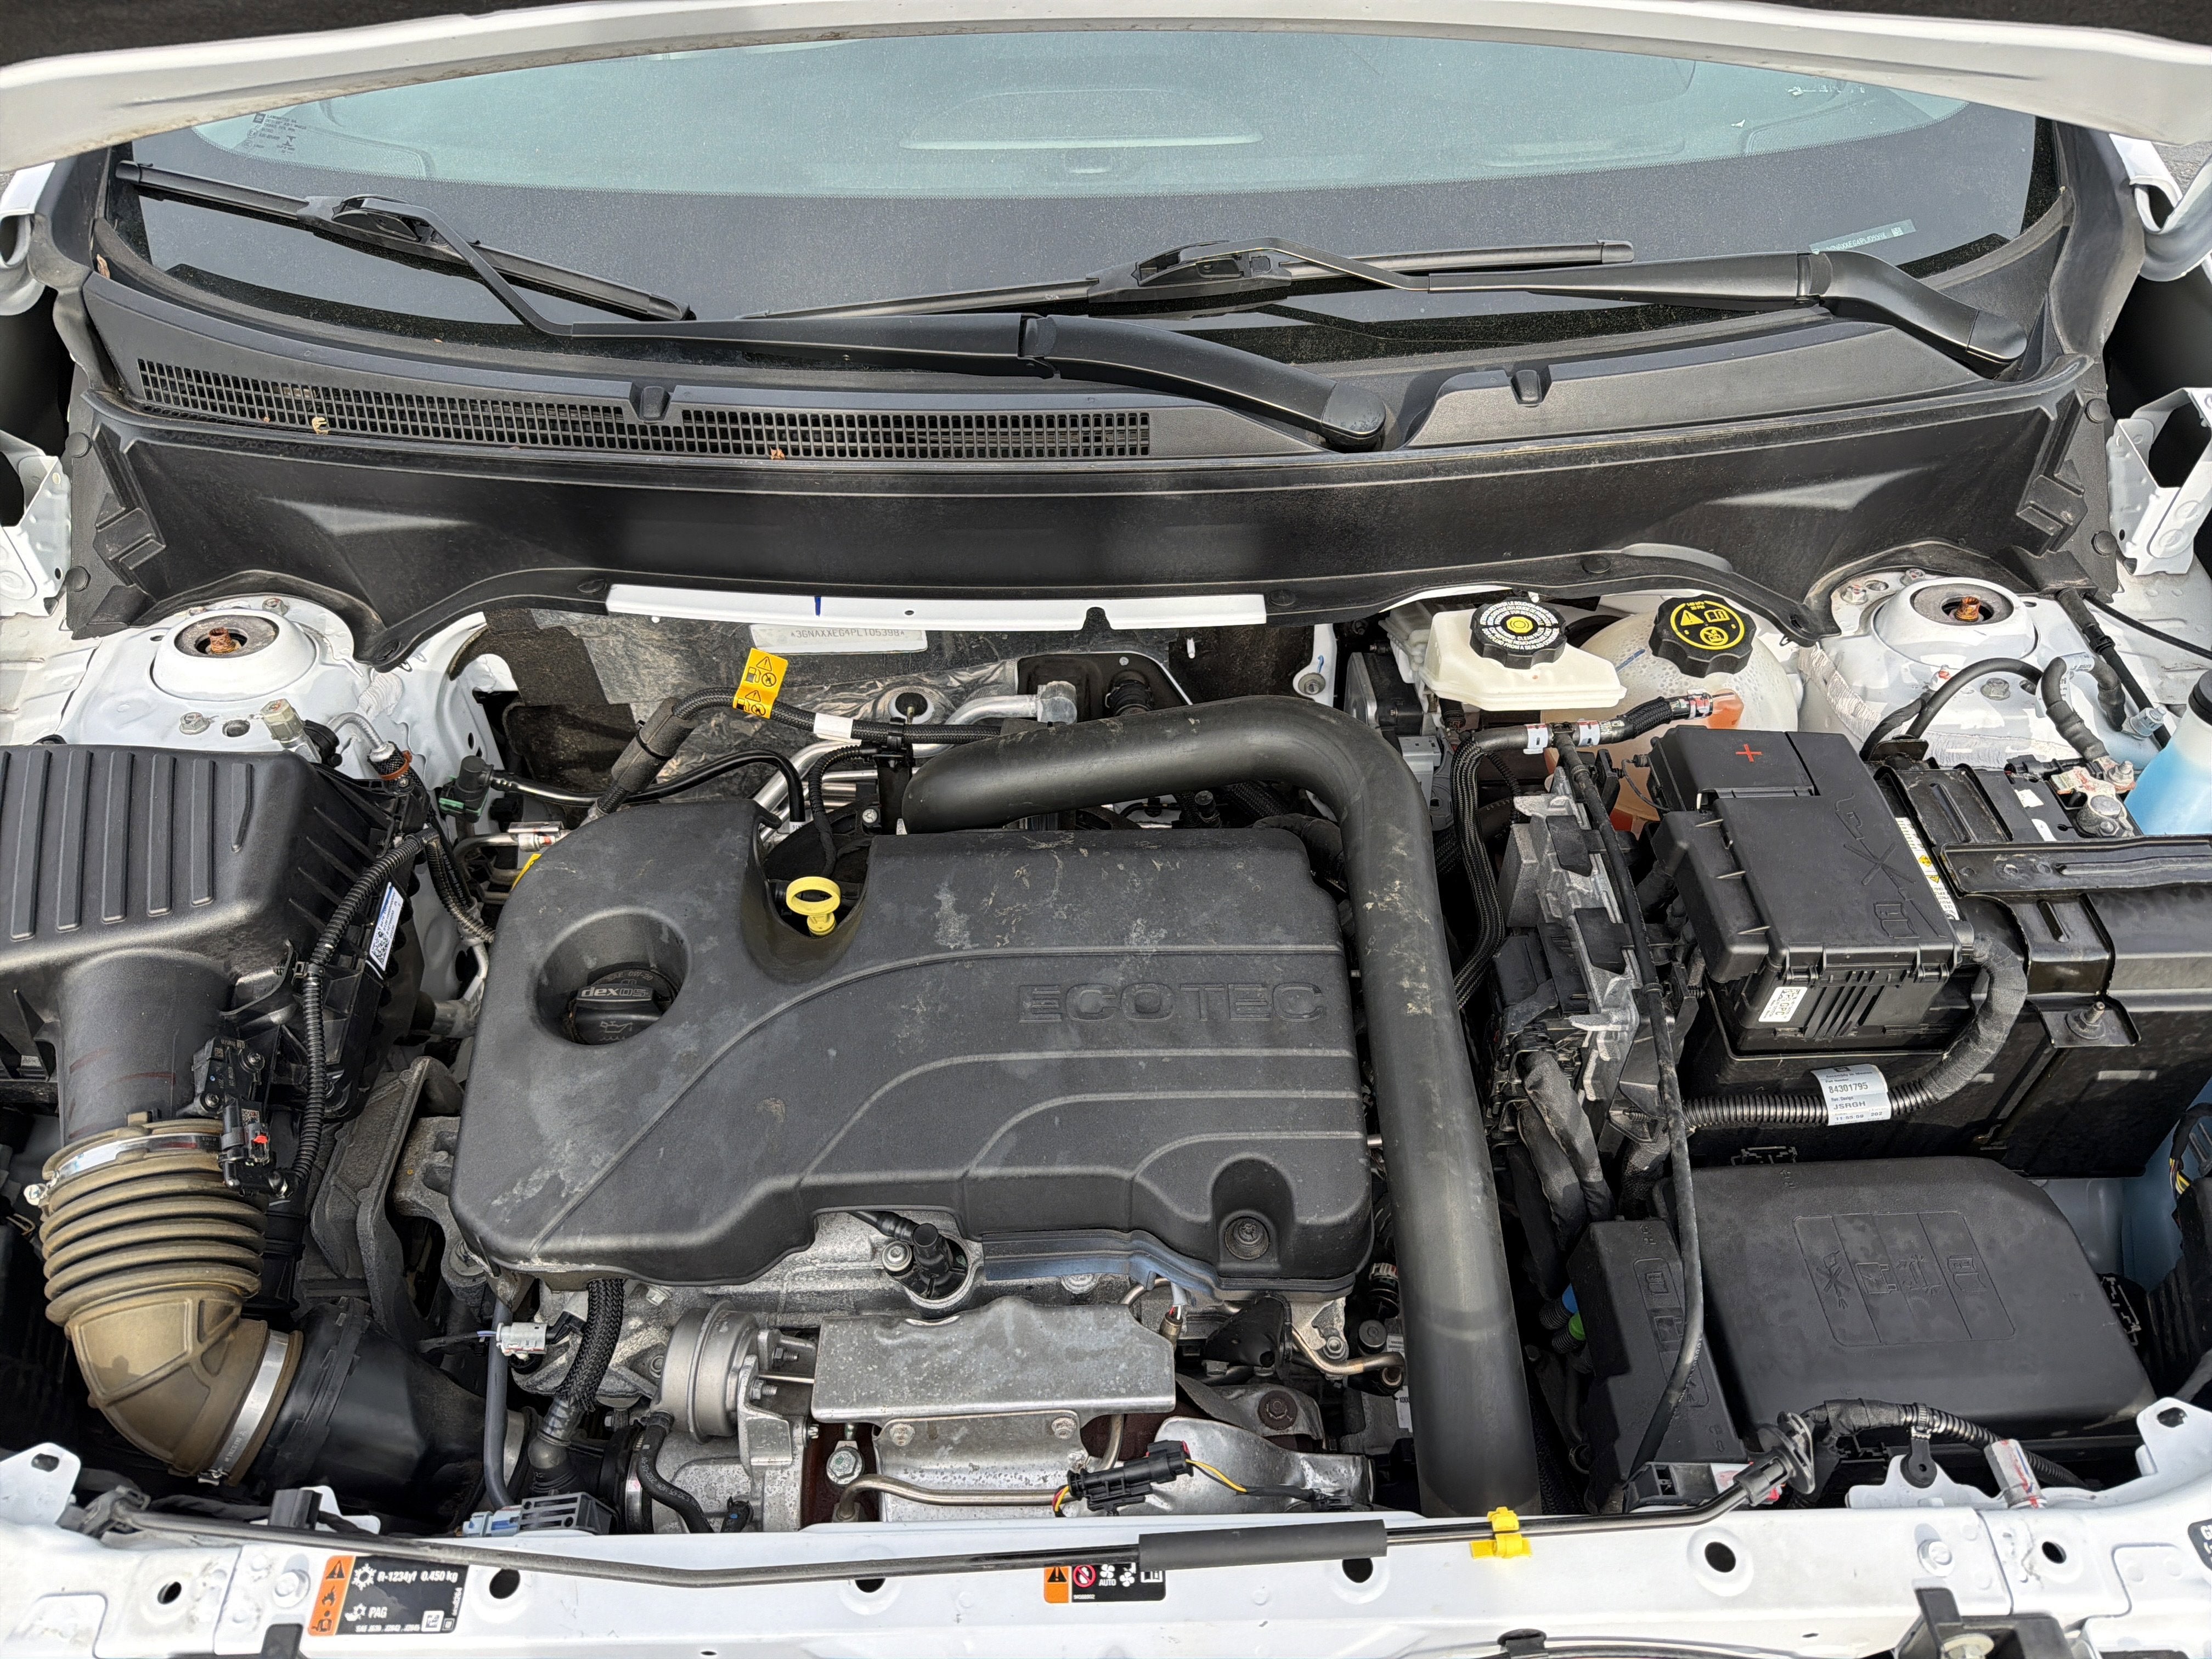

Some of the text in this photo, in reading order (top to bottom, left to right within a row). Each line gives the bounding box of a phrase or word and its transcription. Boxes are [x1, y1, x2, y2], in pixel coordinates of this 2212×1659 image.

[1488, 635, 1504, 645] FLUID
[628, 970, 653, 981] 0W-20
[582, 987, 647, 997] dexos
[1019, 983, 1324, 1023] ECOTEC
[1829, 1082, 1868, 1093] 84301795
[1833, 1101, 1866, 1110] JSRGH
[377, 1570, 459, 1584] R-1234yf 0.450 kg
[1099, 1578, 1117, 1587] AUTO
[368, 1606, 388, 1619] PAG
